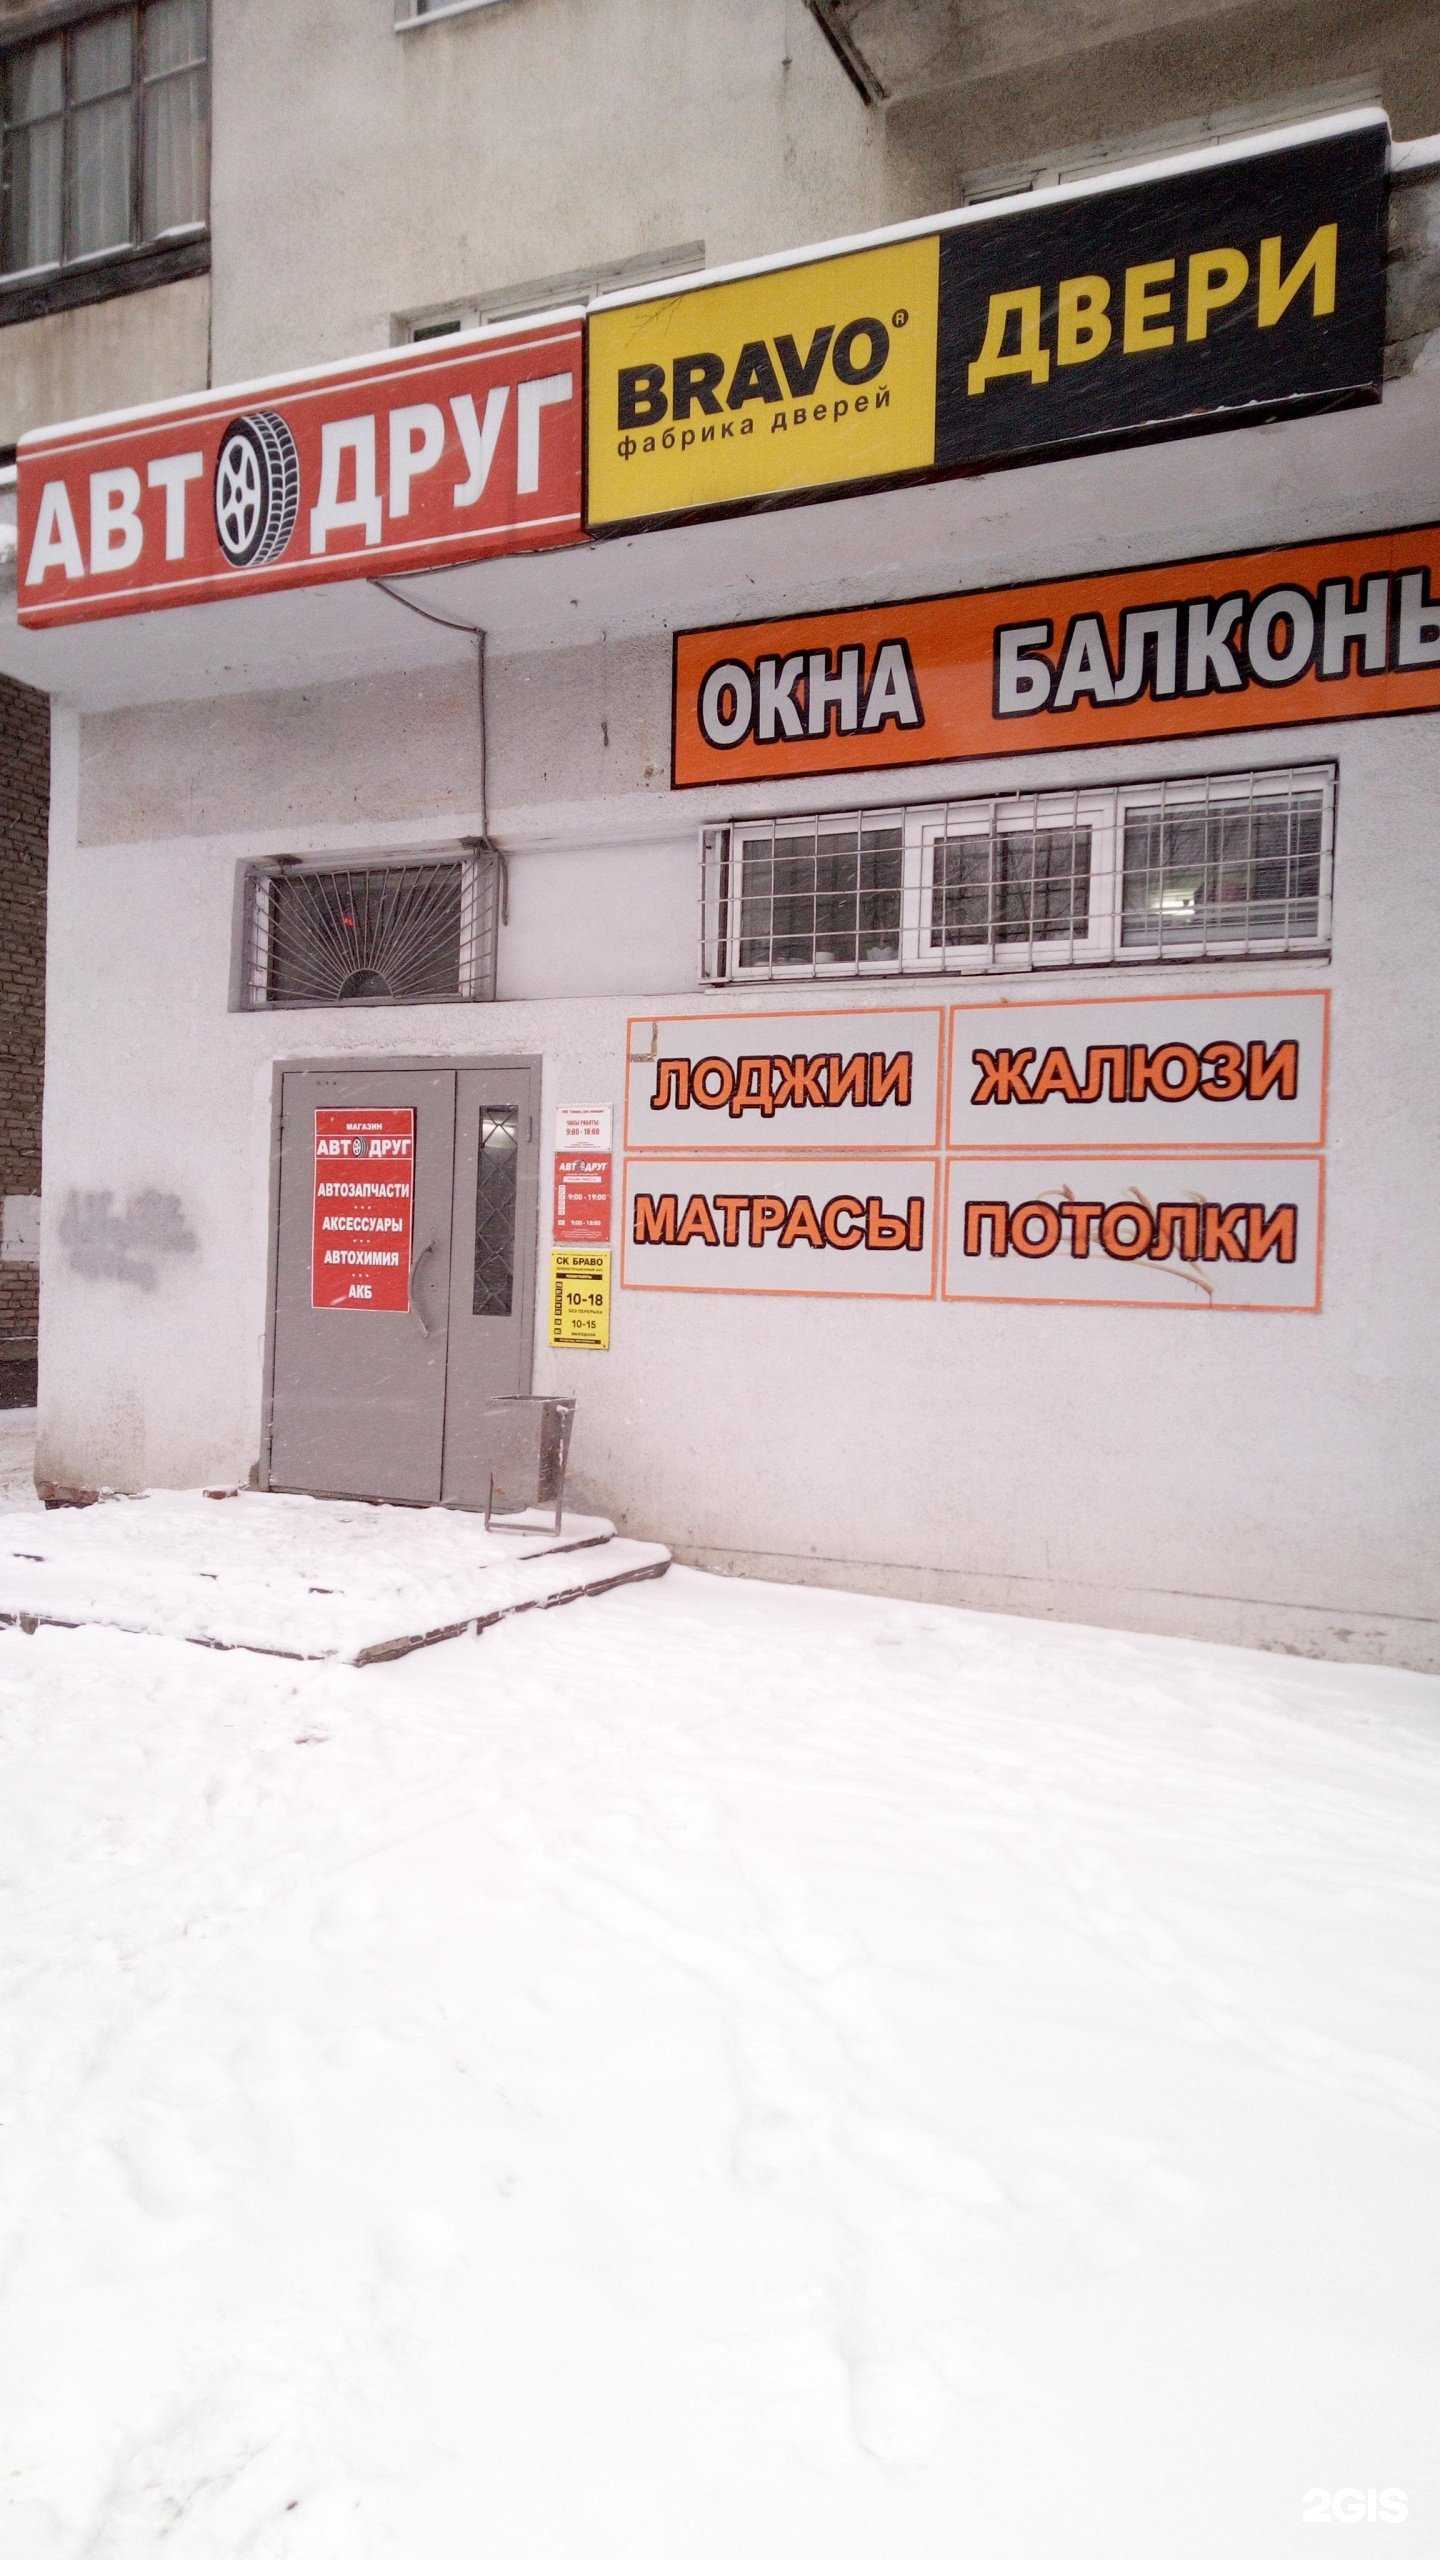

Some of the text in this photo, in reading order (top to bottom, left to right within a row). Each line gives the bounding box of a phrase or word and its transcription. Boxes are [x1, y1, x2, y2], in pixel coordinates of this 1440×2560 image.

[967, 223, 1338, 396] ДВЕРИ
[618, 317, 889, 430] BRAVO
[617, 385, 891, 460] фабрика дверей
[700, 638, 925, 749] ОКНА
[650, 1050, 912, 1118] ЛОДЖИИ
[971, 1040, 1299, 1106] ЖАЛЮЗИ
[346, 1123, 383, 1131] МАГАЗИН
[317, 1182, 410, 1198] АВТОЗАПЧАСТИ
[322, 1216, 403, 1232] АКСЕССУАРЫ
[634, 1194, 926, 1252] МАТРАСЫ
[963, 1200, 1298, 1264] ПОТОЛКИ
[324, 1250, 399, 1266] АВТОХИМИЯ
[556, 1257, 603, 1266] СК БРАВО
[348, 1284, 373, 1300] АКБ
[566, 1293, 603, 1307] 10-18
[571, 1319, 597, 1329] 10-15
